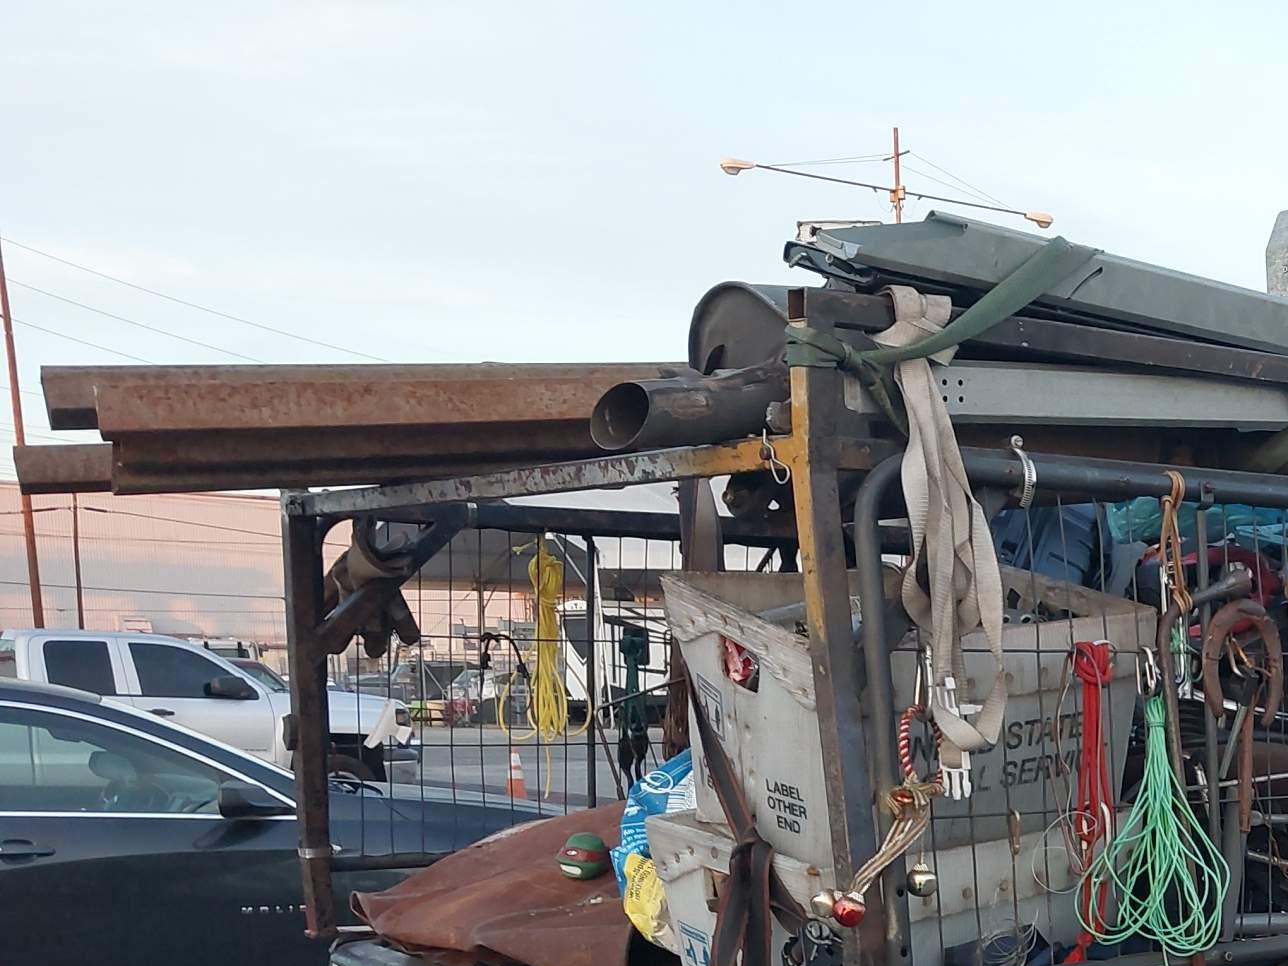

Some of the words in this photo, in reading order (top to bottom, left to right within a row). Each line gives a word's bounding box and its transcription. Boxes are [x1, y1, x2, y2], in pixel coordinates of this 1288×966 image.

[766, 778, 804, 801] LABEL
[767, 797, 808, 819] OTHER
[776, 814, 800, 834] END
